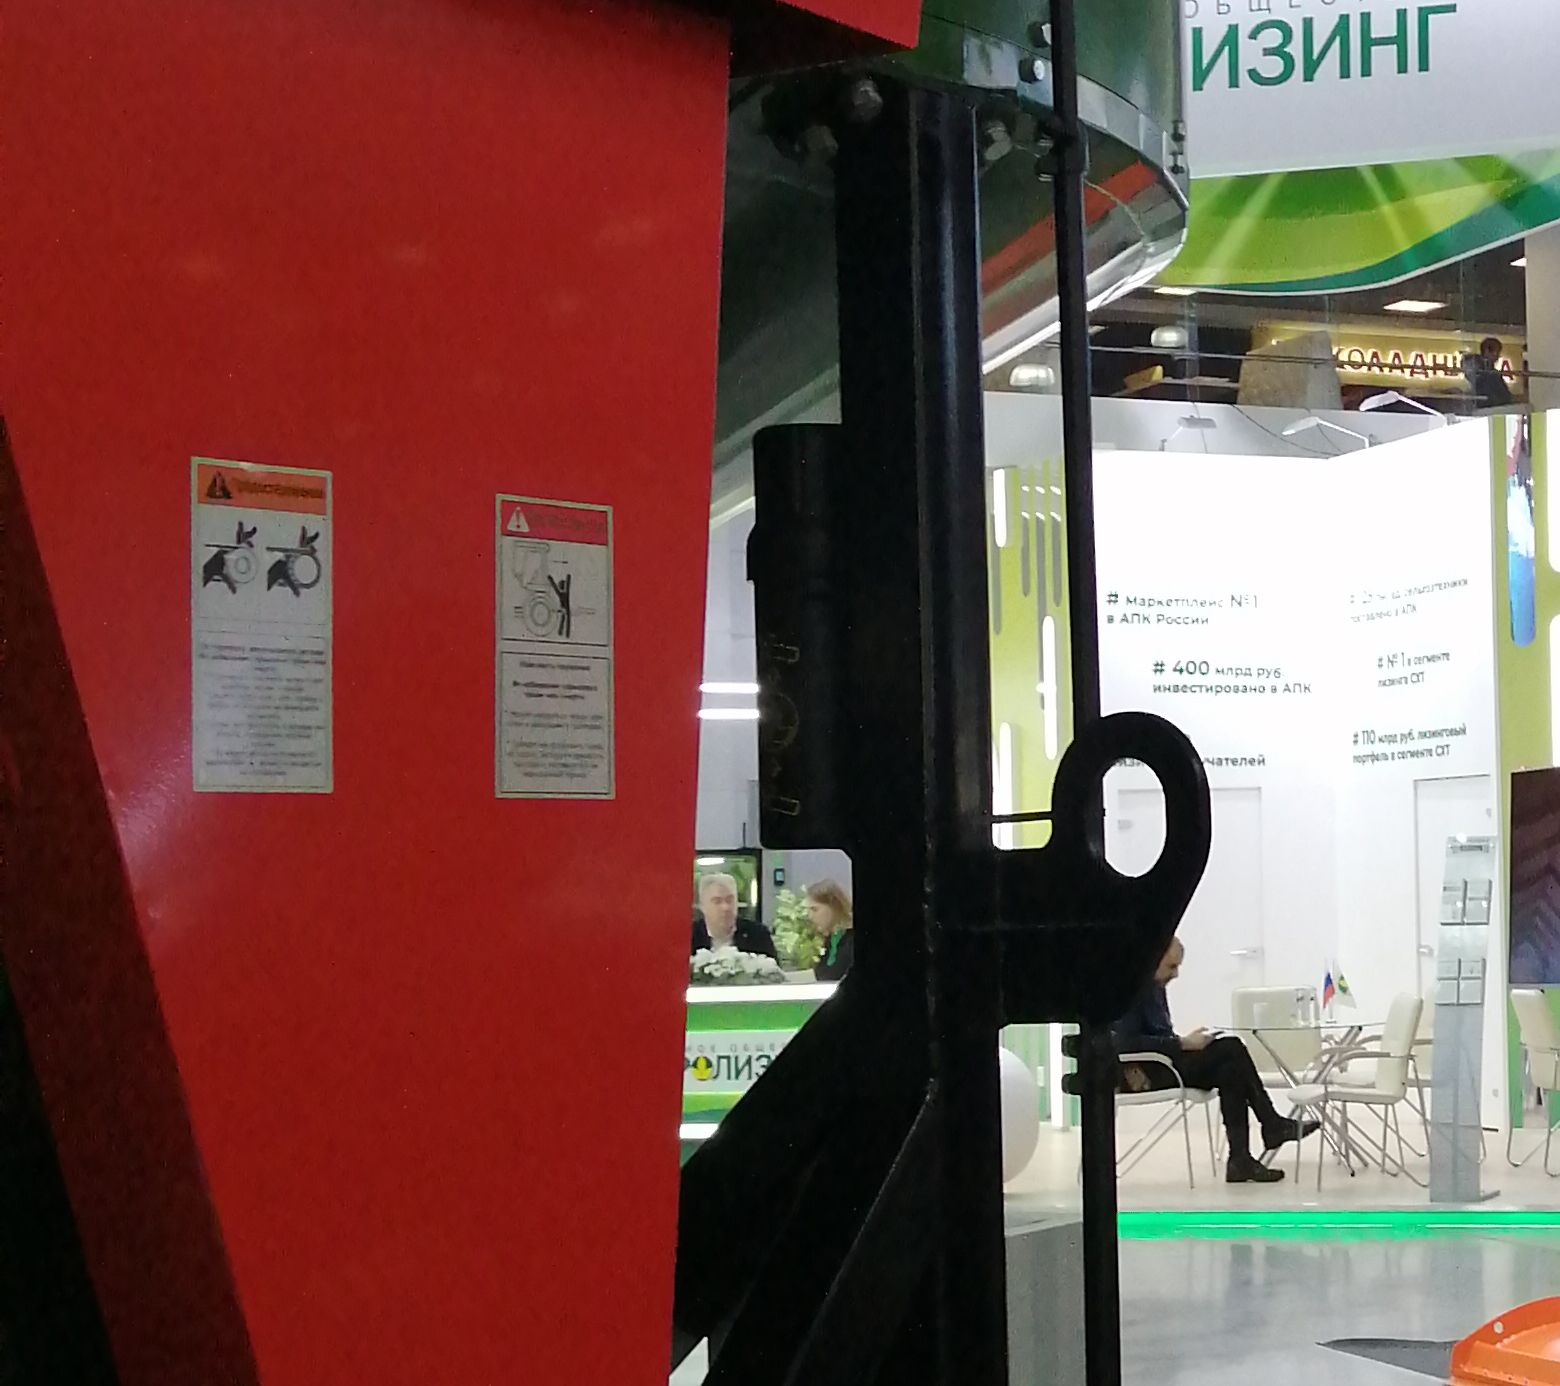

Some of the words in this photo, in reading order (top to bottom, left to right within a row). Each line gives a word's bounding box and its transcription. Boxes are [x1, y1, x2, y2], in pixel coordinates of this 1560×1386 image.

[1120, 613, 1151, 625] АПК
[1156, 613, 1209, 625] России
[1172, 660, 1210, 676] 400
[1215, 666, 1252, 678] млрд
[1152, 683, 1266, 696] инвестировано
[1282, 683, 1313, 693] АПК
